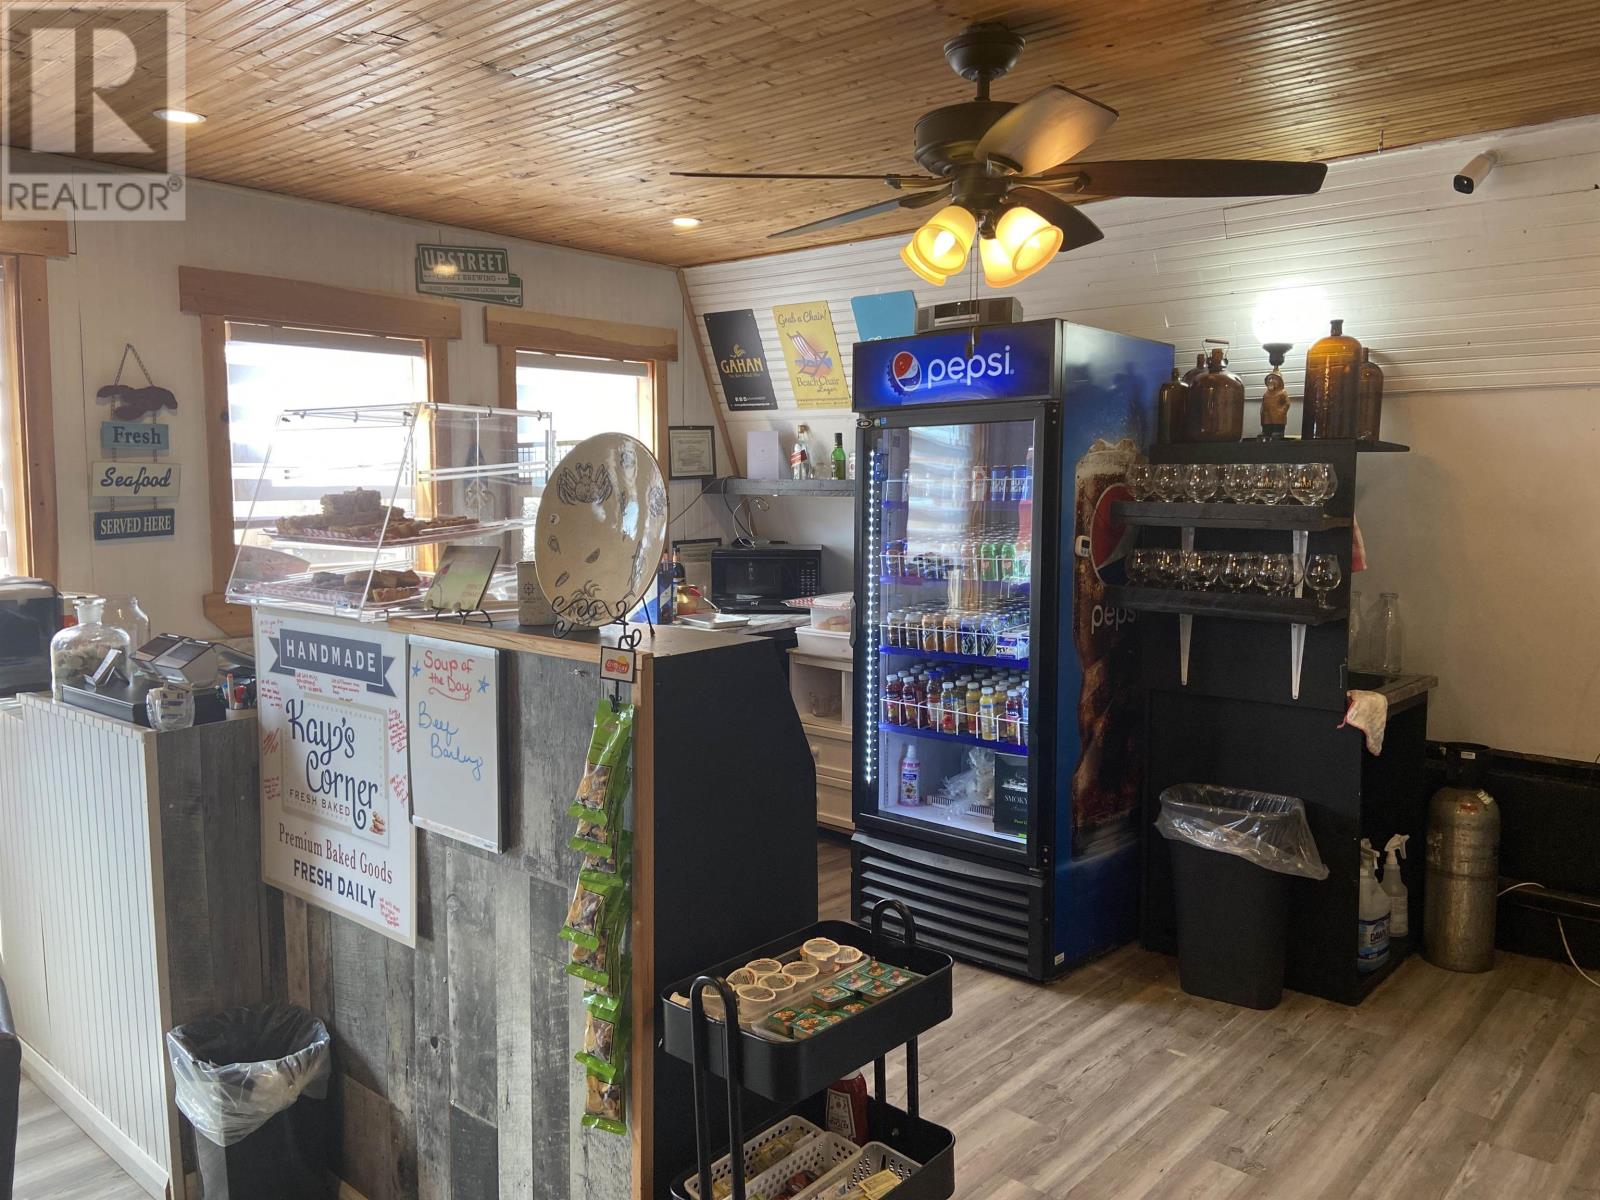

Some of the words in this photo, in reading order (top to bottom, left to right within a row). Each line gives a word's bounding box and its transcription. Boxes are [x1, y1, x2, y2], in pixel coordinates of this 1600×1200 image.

[424, 249, 503, 273] UPSTREET
[720, 357, 764, 374] GAHAN
[927, 344, 1011, 389] pepsi
[112, 426, 161, 444] Fresh
[100, 466, 172, 494] Seafood
[100, 517, 141, 535] SERVED
[143, 515, 172, 532] HERE
[286, 638, 376, 673] HANDMADE
[424, 650, 459, 677] Soup
[461, 659, 475, 674] of
[428, 672, 445, 686] the
[447, 677, 472, 699] Day
[286, 699, 355, 765] Kay's
[418, 700, 459, 745] Beef
[431, 733, 484, 781] Barley
[289, 788, 317, 806] FRESH
[321, 794, 351, 816] BAKED
[306, 750, 378, 830] Corner
[278, 822, 323, 858] Premium
[326, 839, 356, 870] Baked
[360, 852, 393, 884] Goods
[294, 859, 333, 891] FRESH
[337, 876, 376, 909] DAILY
